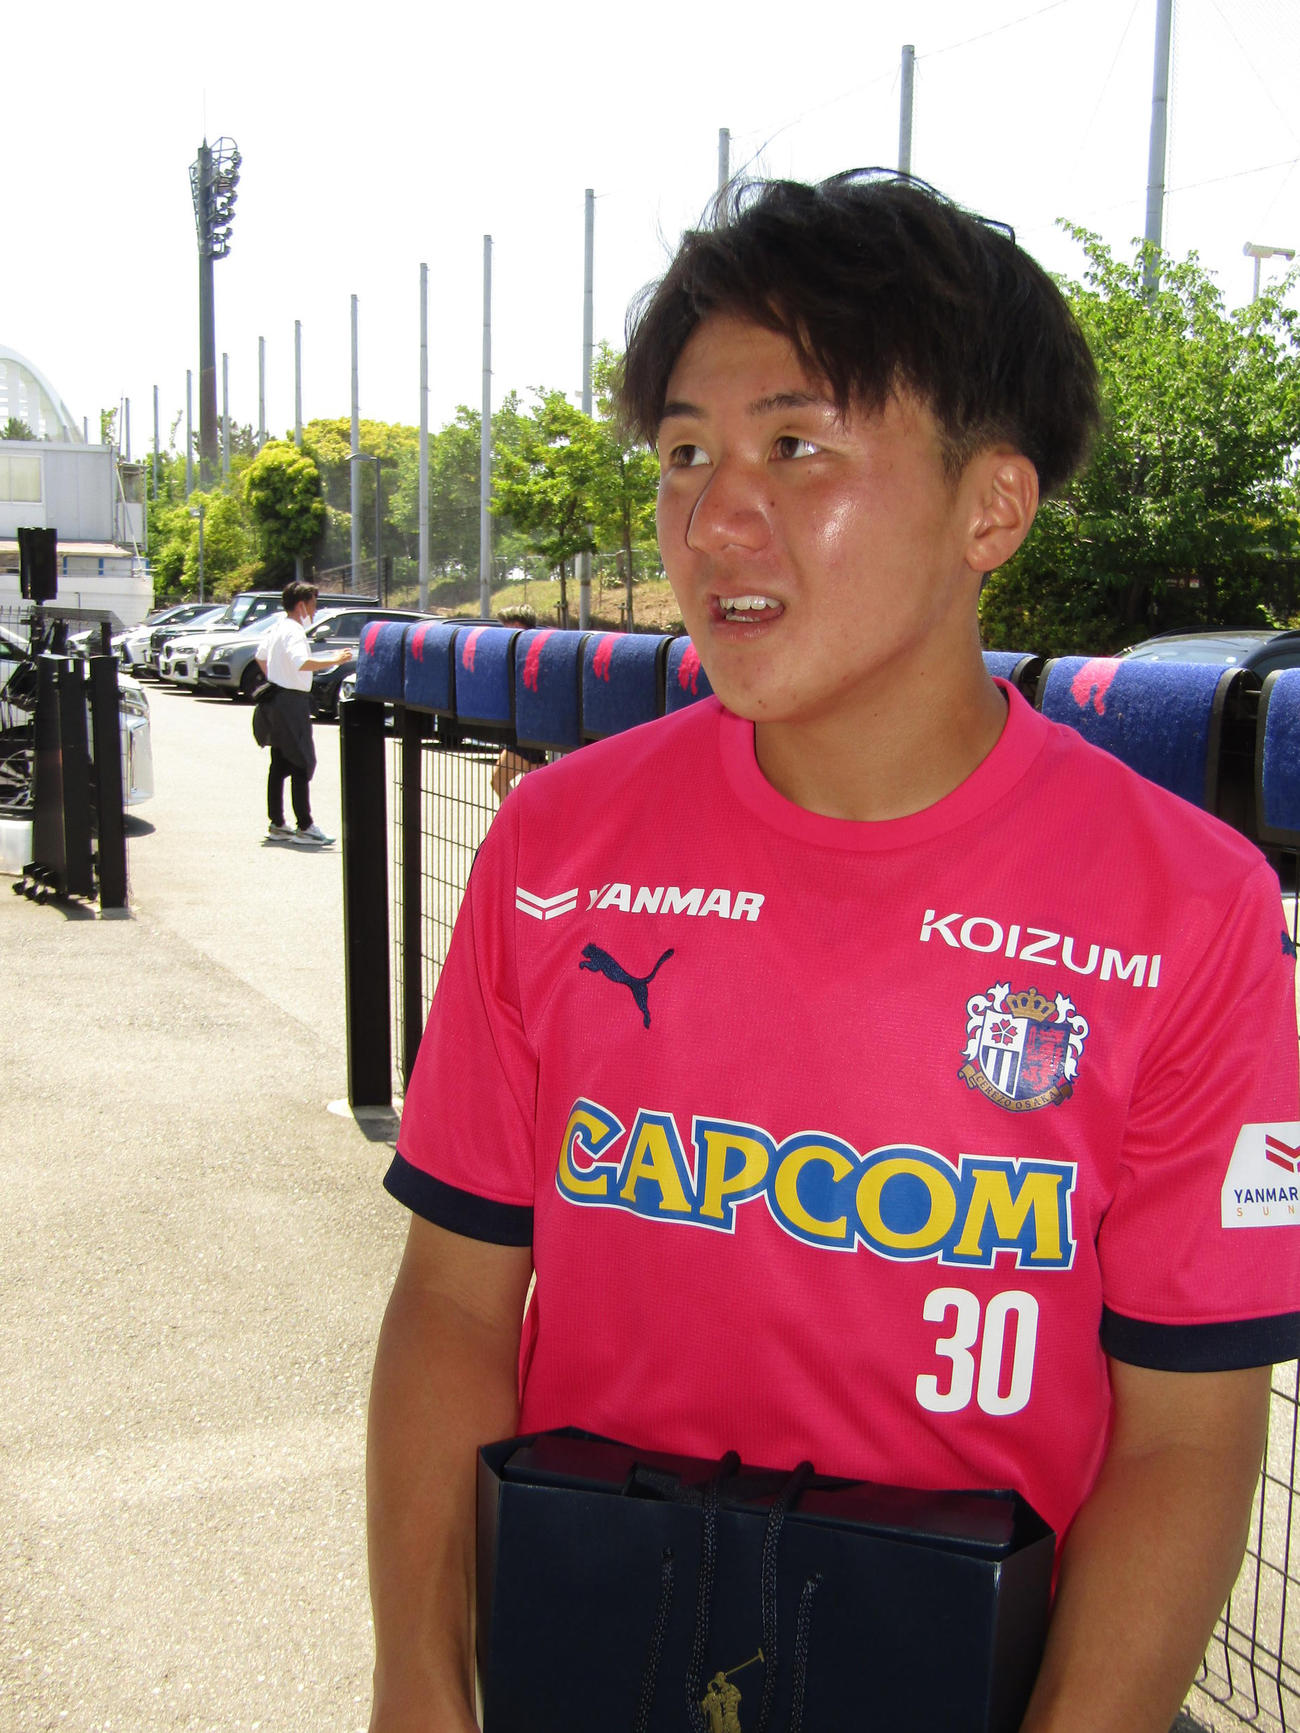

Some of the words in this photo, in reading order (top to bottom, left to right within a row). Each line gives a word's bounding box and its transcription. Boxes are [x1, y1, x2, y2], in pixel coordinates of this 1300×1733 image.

[586, 883, 765, 922] YANMAR
[920, 909, 1162, 988] KOIZUMI
[976, 1075, 1012, 1107] CEREZO
[1016, 1091, 1056, 1109] OSAKA
[556, 1097, 1077, 1270] CAPCOM
[1234, 1186, 1298, 1204] YANMAR
[916, 1287, 1039, 1416] 30
